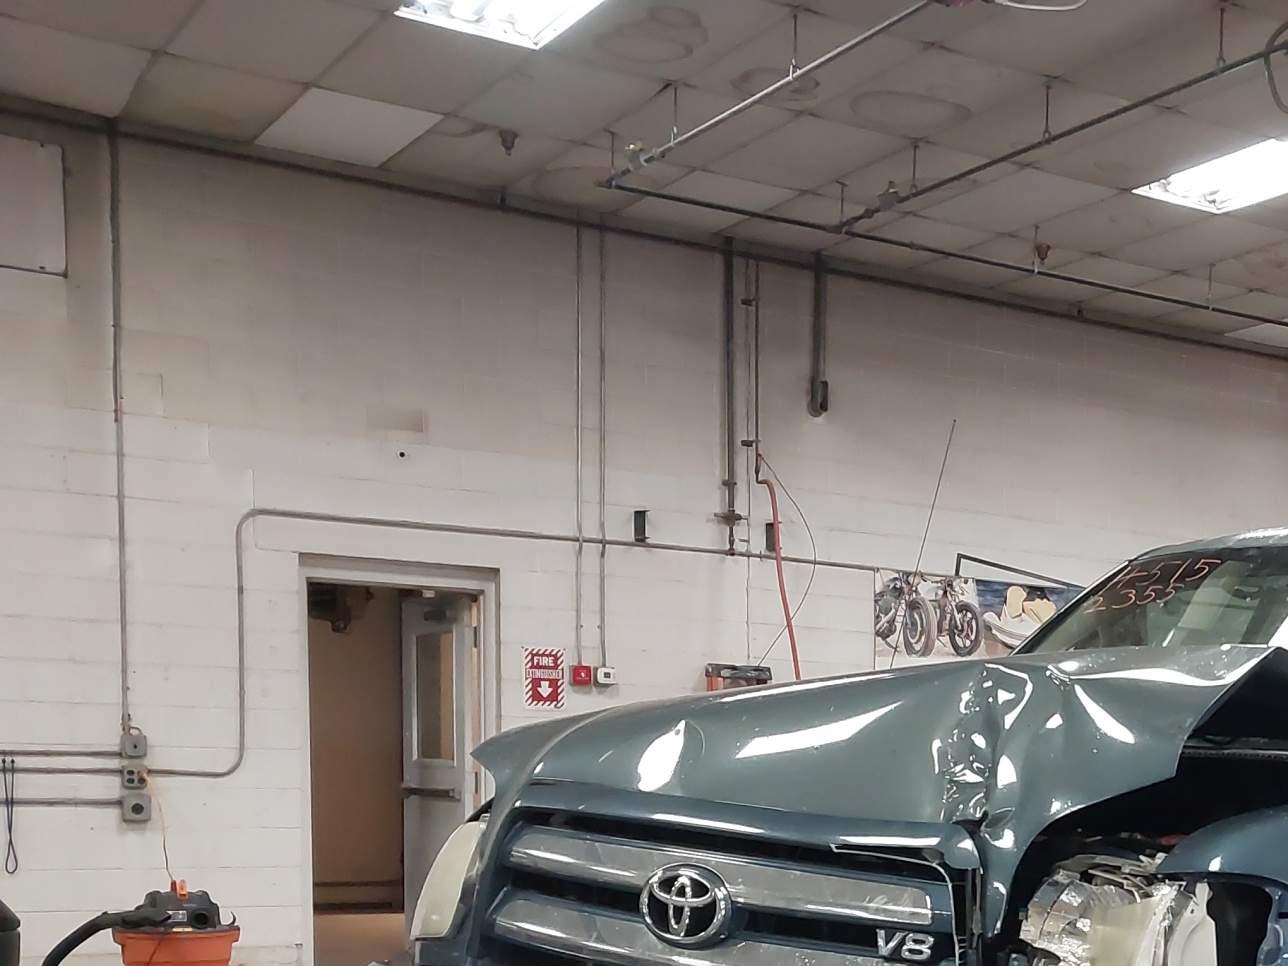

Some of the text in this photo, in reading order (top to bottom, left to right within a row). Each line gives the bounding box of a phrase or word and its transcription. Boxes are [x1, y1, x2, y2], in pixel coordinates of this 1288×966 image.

[1083, 583, 1185, 614] 2355
[533, 656, 555, 667] FIRE
[876, 928, 935, 961] V8
